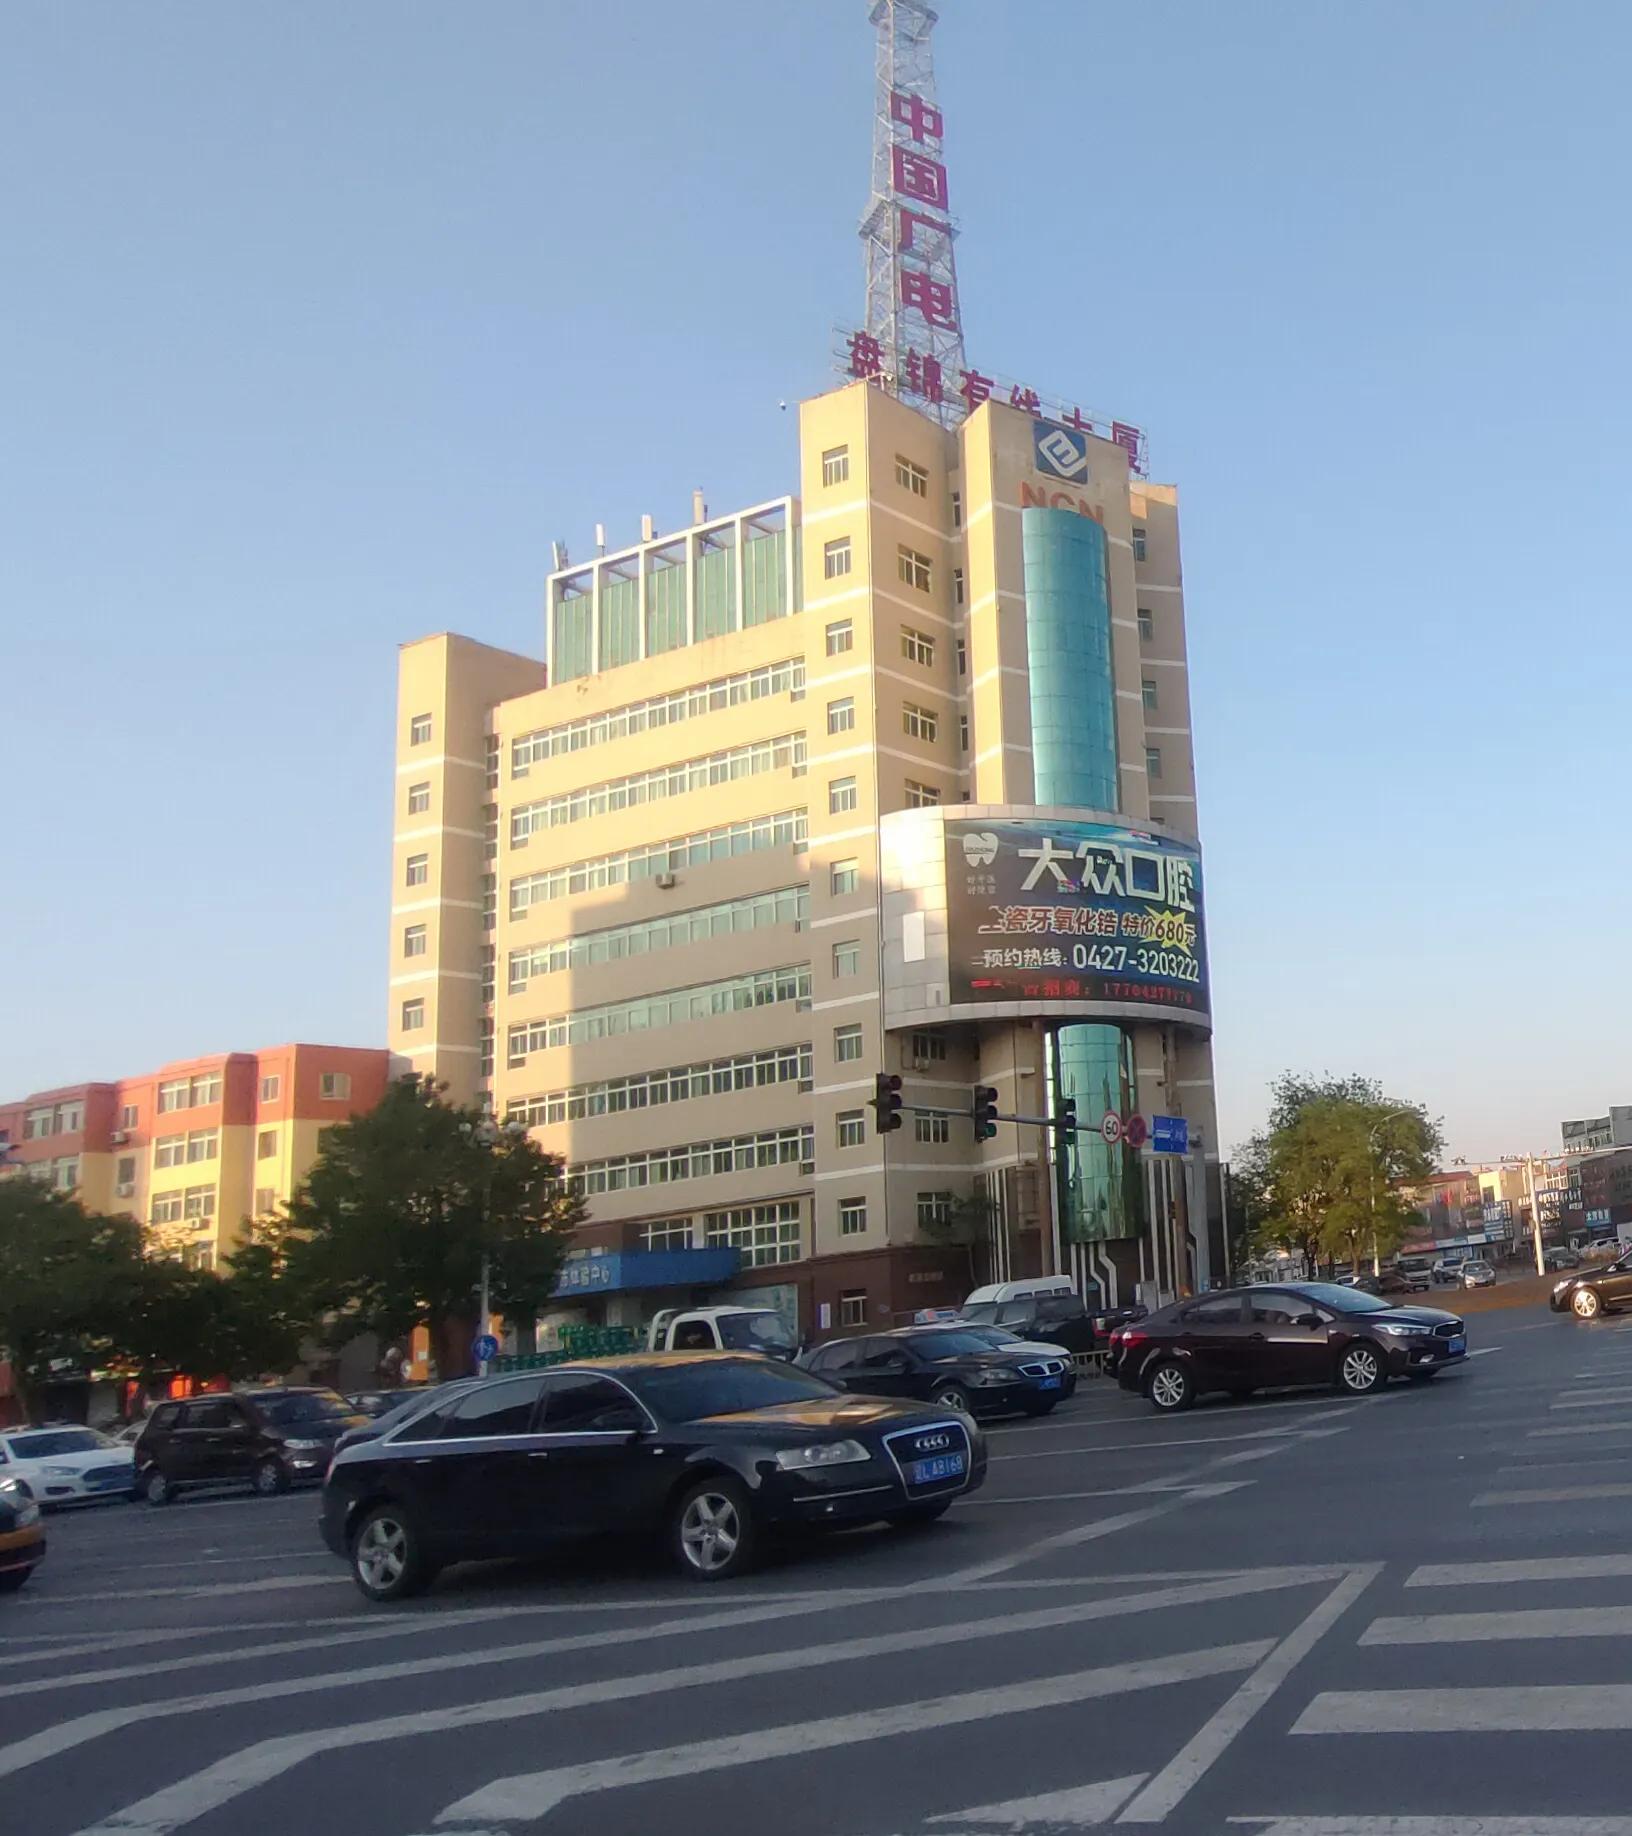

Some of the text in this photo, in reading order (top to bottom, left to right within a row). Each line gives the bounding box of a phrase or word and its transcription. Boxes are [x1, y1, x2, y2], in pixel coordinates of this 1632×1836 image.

[1018, 838, 1196, 913] 大众口腔
[978, 905, 1118, 937] 瓷牙氧化锆
[1073, 943, 1200, 984] 0427-3203222
[1105, 1120, 1117, 1136] 60
